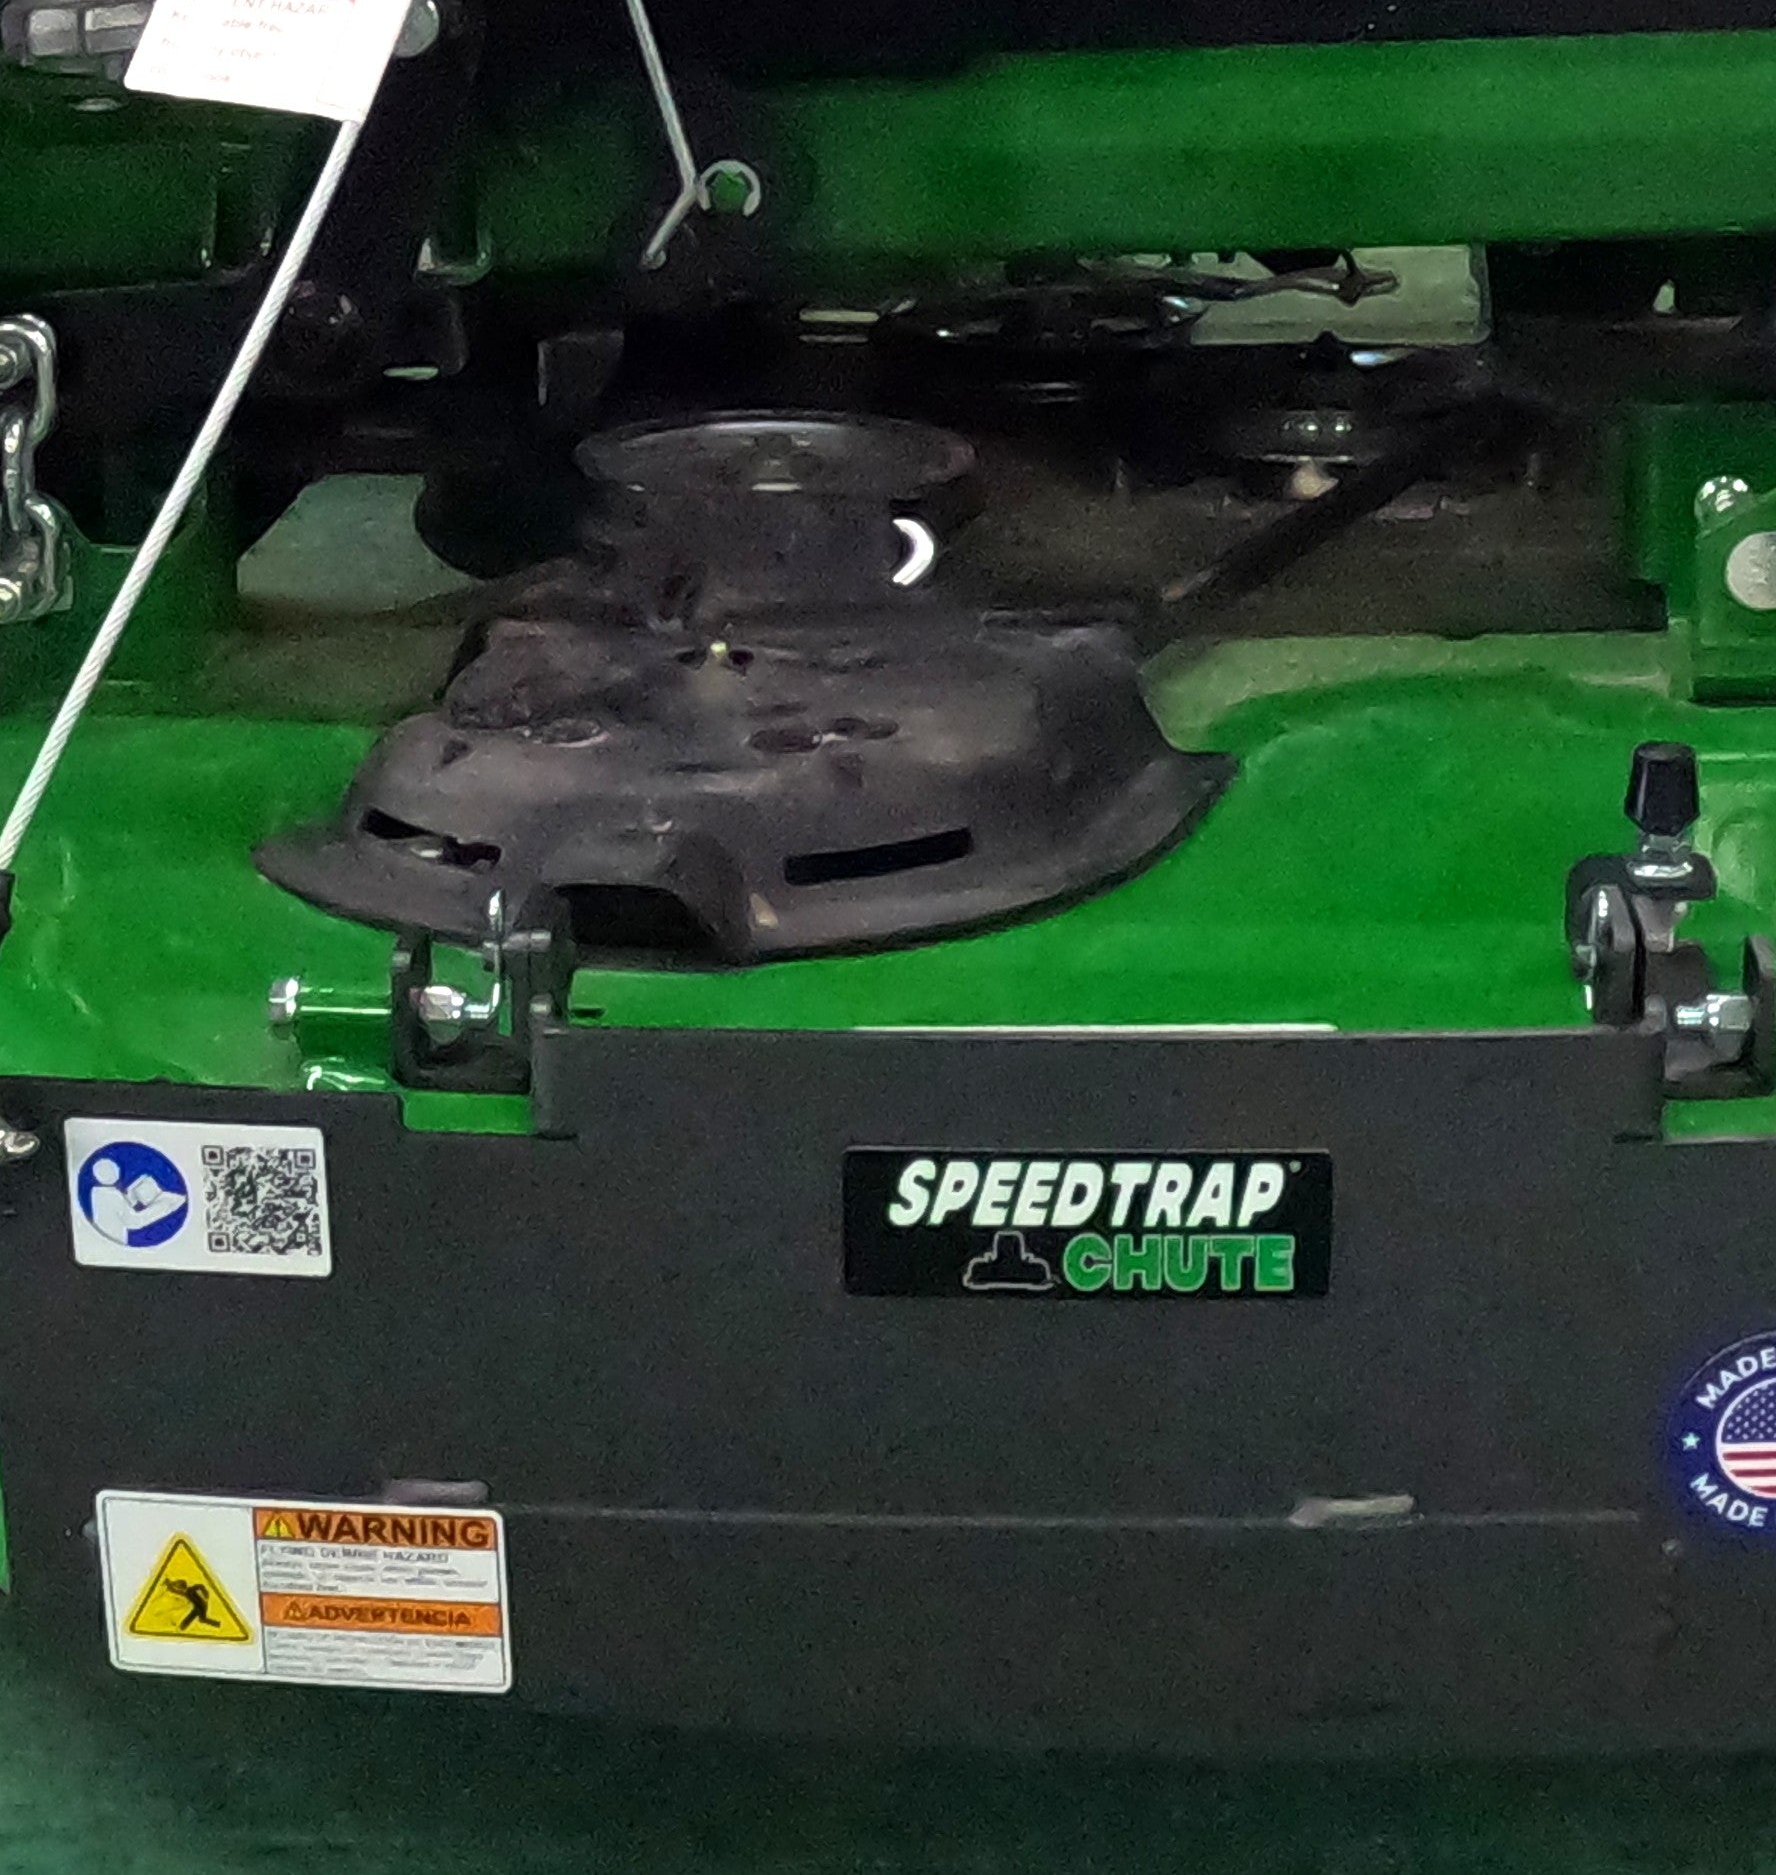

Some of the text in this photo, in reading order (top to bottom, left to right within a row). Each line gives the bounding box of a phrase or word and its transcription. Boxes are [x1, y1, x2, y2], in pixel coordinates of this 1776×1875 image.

[888, 1158, 1285, 1228] SPEEDTRAP
[1062, 1232, 1297, 1293] CHUTE
[1689, 1472, 1769, 1528] MADE
[297, 1512, 490, 1547] WARNING
[307, 1604, 473, 1631] ADVERTENCIA
